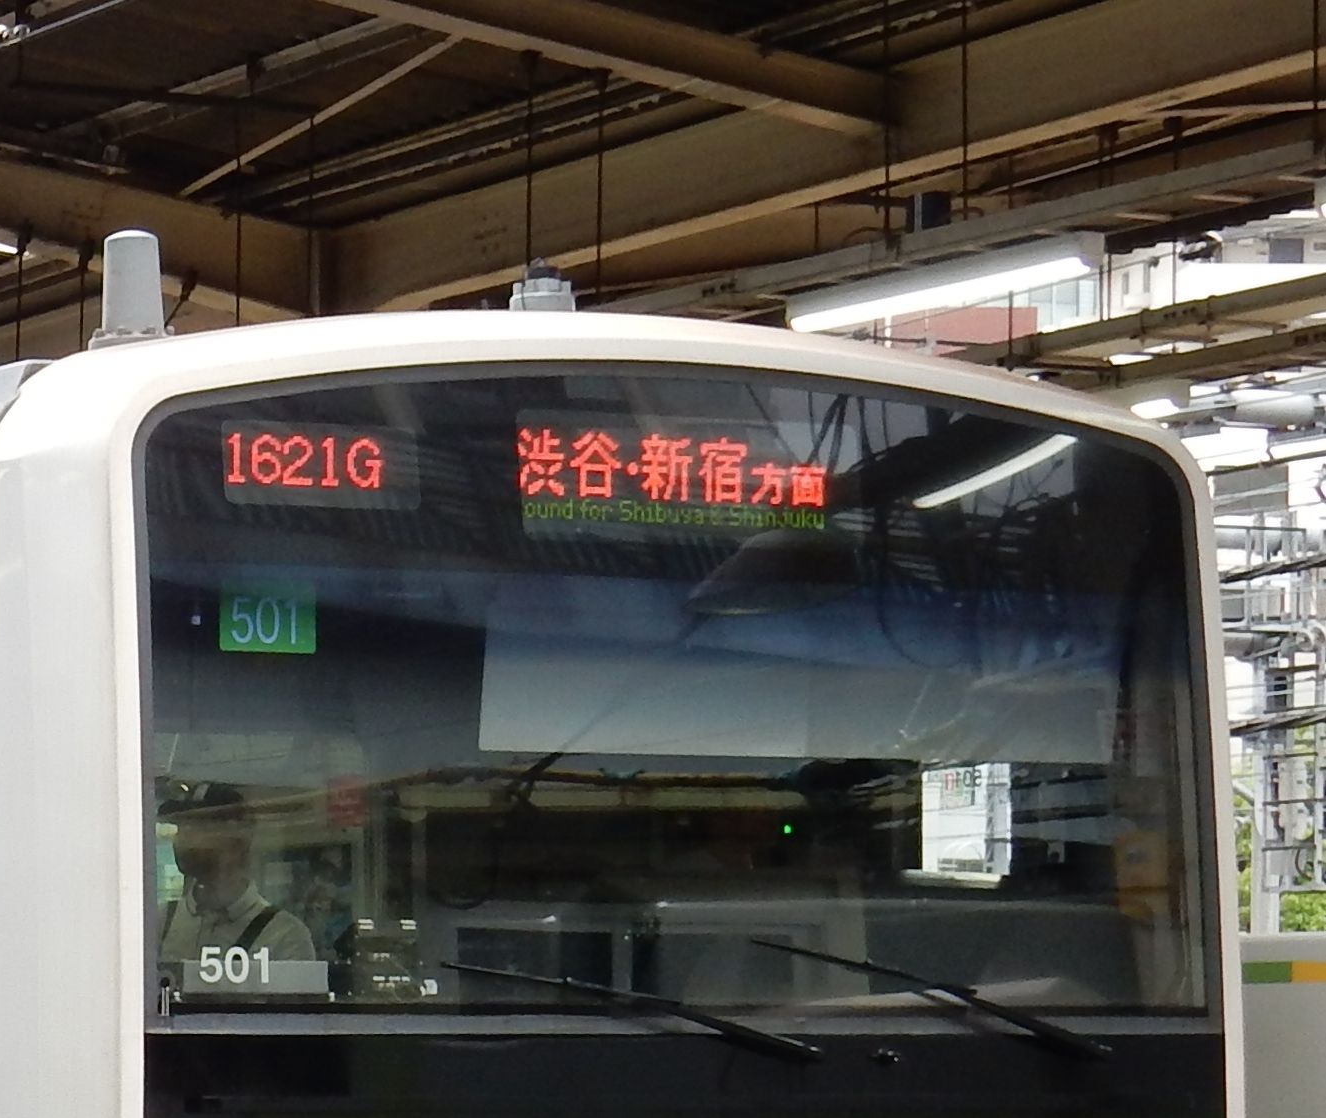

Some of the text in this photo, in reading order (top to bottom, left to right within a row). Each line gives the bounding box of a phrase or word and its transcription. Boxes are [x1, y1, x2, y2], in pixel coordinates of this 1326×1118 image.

[227, 432, 385, 489] 1621G
[522, 498, 575, 521] ound
[580, 498, 614, 521] for
[618, 500, 705, 525] Shibuya
[728, 503, 825, 530] Shinjuku
[229, 596, 298, 645] 501
[199, 946, 270, 984] 501
